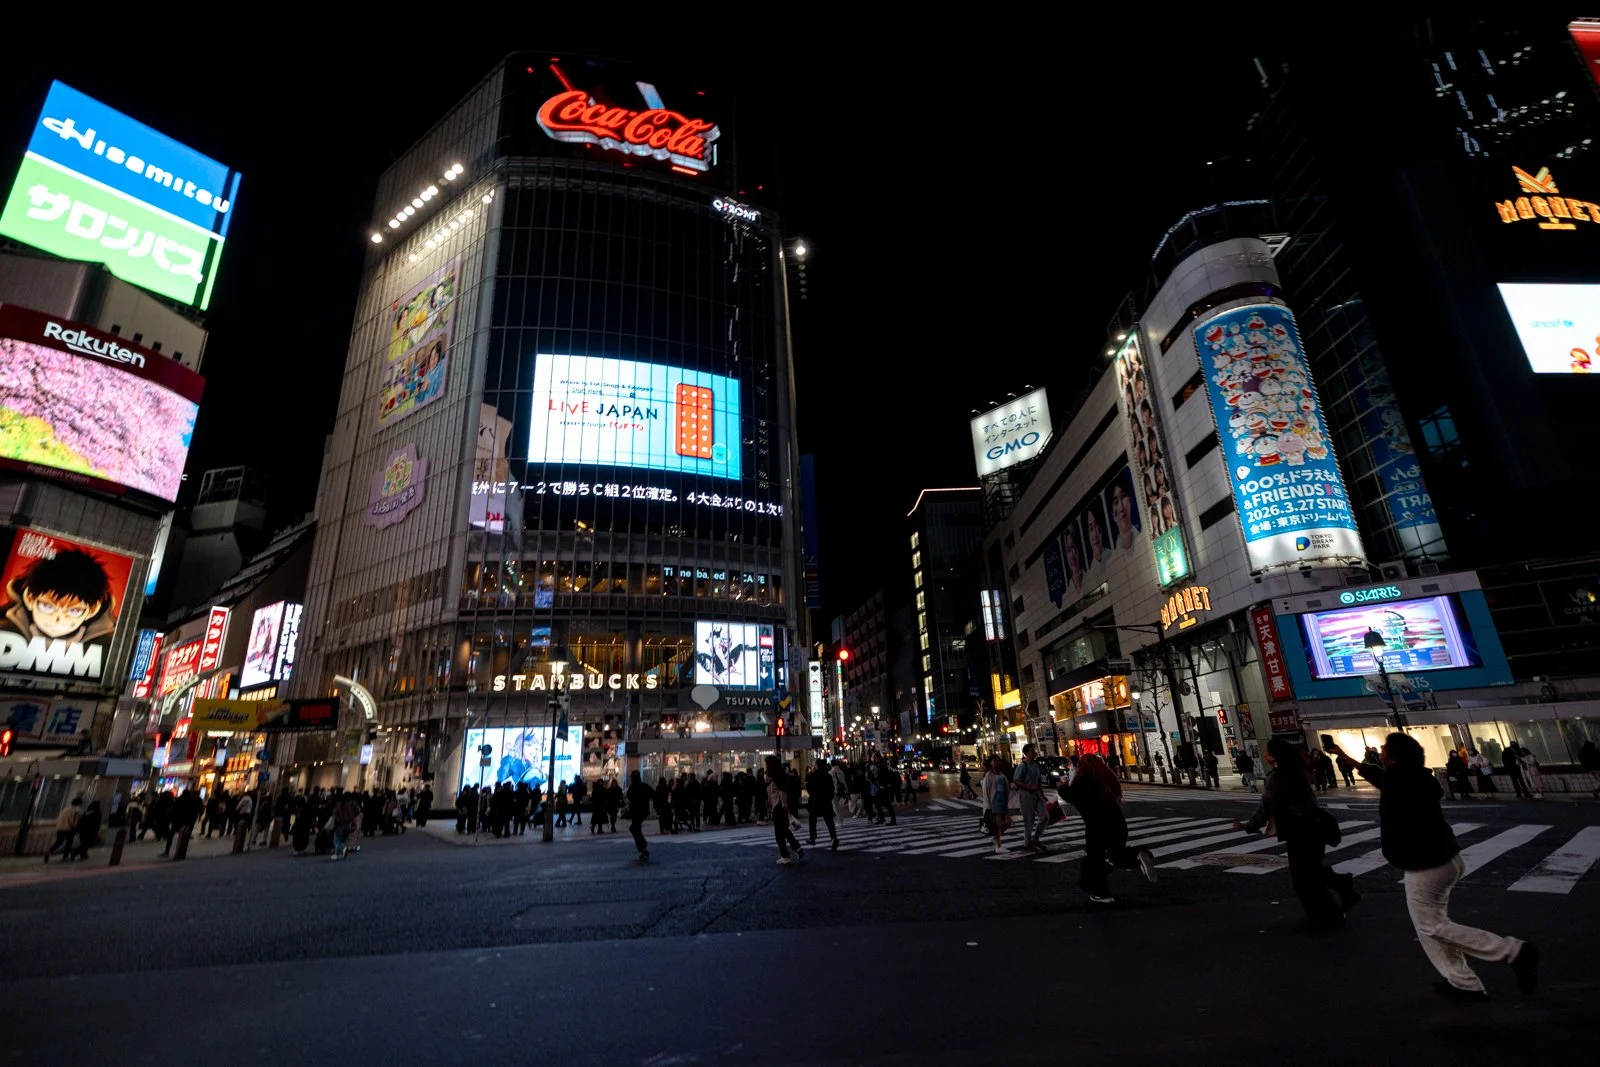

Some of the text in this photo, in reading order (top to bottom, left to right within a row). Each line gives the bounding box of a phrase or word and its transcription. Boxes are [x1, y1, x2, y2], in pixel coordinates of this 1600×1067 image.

[539, 90, 715, 158] Coca-Cola
[42, 116, 231, 214] Hisamitsu
[27, 183, 205, 284] サロンパス
[43, 321, 147, 369] Rakuten
[549, 399, 658, 420] LIVE JAPAN
[982, 405, 1037, 434] すべての人に
[984, 416, 1038, 444] インターネット
[986, 431, 1040, 460] GMO
[1243, 483, 1325, 510] &FRIENDS
[1247, 497, 1348, 524] 2026.3.27 START
[1160, 586, 1211, 630] MAGNET
[0, 629, 103, 678] DMM
[168, 643, 200, 668] カラオケ
[1259, 624, 1286, 692] 天津甘栗
[493, 673, 658, 692] STARBUCKS
[725, 697, 771, 707] TSUTAYA
